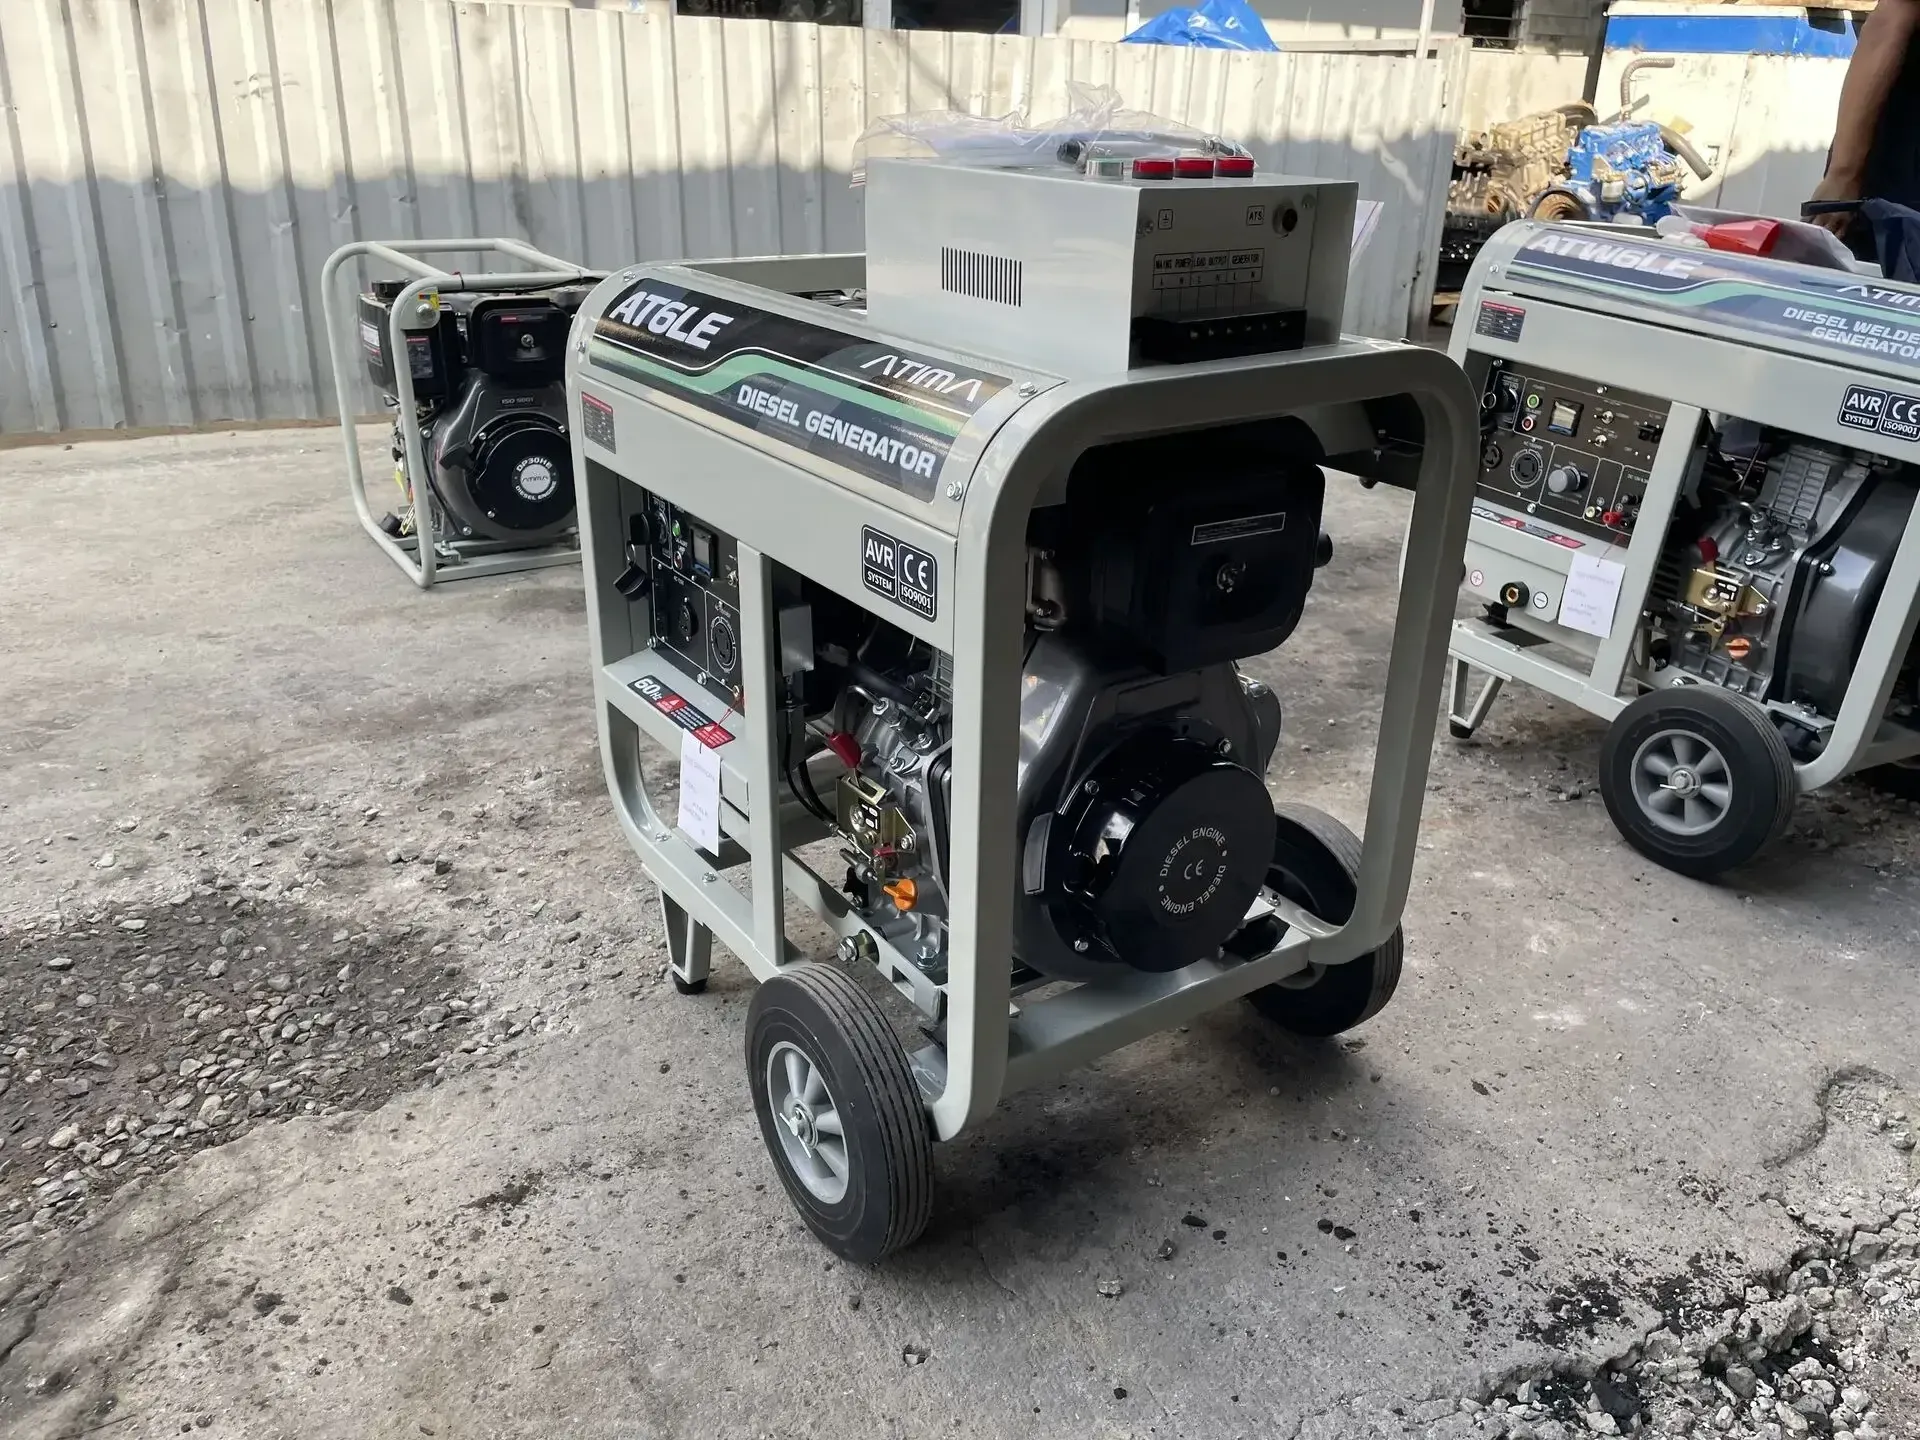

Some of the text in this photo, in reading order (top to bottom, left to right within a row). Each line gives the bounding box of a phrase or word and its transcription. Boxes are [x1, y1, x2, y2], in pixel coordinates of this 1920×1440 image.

[1526, 233, 1703, 280] ATW6LE
[1836, 285, 1920, 307] ATIM
[608, 291, 734, 350] AT6LE
[1782, 306, 1920, 345] DIESEL WELDE
[860, 354, 983, 403] ATIMA
[1846, 392, 1882, 413] AVR
[736, 384, 936, 479] DIESEL GENERATOR
[1844, 413, 1874, 426] SYSTEM
[1883, 420, 1918, 435] ISO9001
[515, 485, 537, 501] DIESEL
[865, 538, 894, 571] AVR
[867, 570, 892, 592] SYSTEM
[901, 584, 931, 609] ISO9001
[633, 678, 663, 701] 60Hz
[1160, 826, 1226, 877] DIESEL ENGINE
[1160, 865, 1227, 914] DIESEL ENGINE
